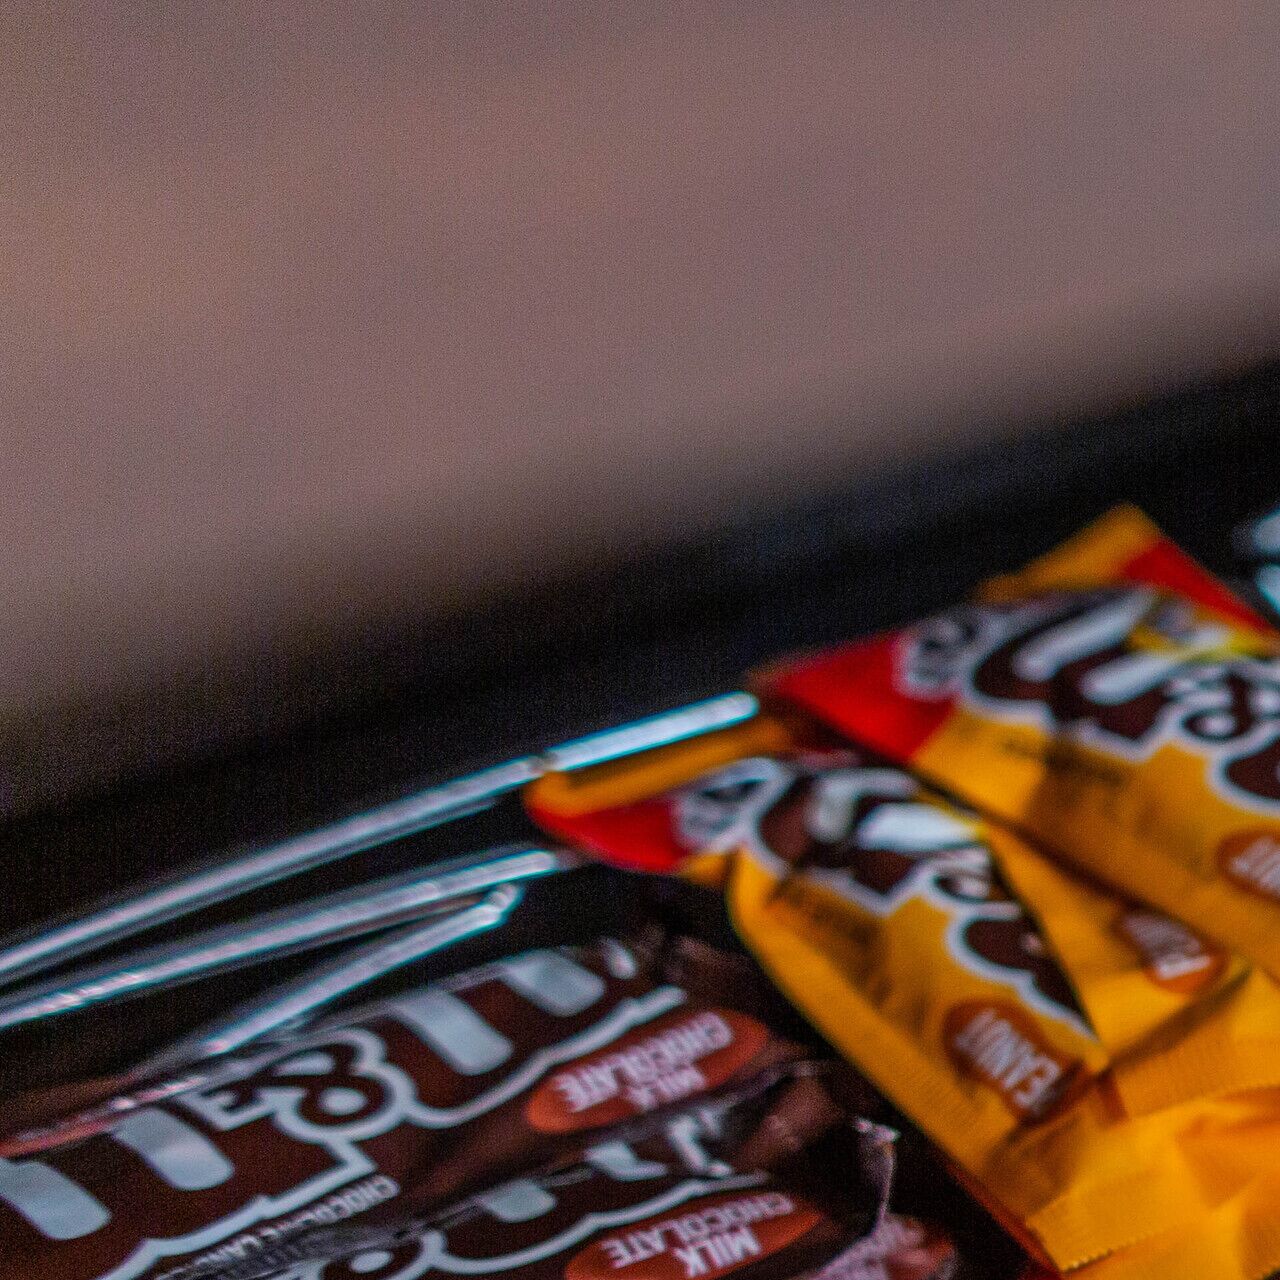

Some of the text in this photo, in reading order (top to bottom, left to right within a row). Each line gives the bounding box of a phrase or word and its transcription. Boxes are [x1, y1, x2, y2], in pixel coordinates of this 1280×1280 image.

[553, 1008, 738, 1114] CHOCOLATE
[600, 1190, 798, 1270] CHOCOLATE
[682, 1215, 764, 1278] MILK
